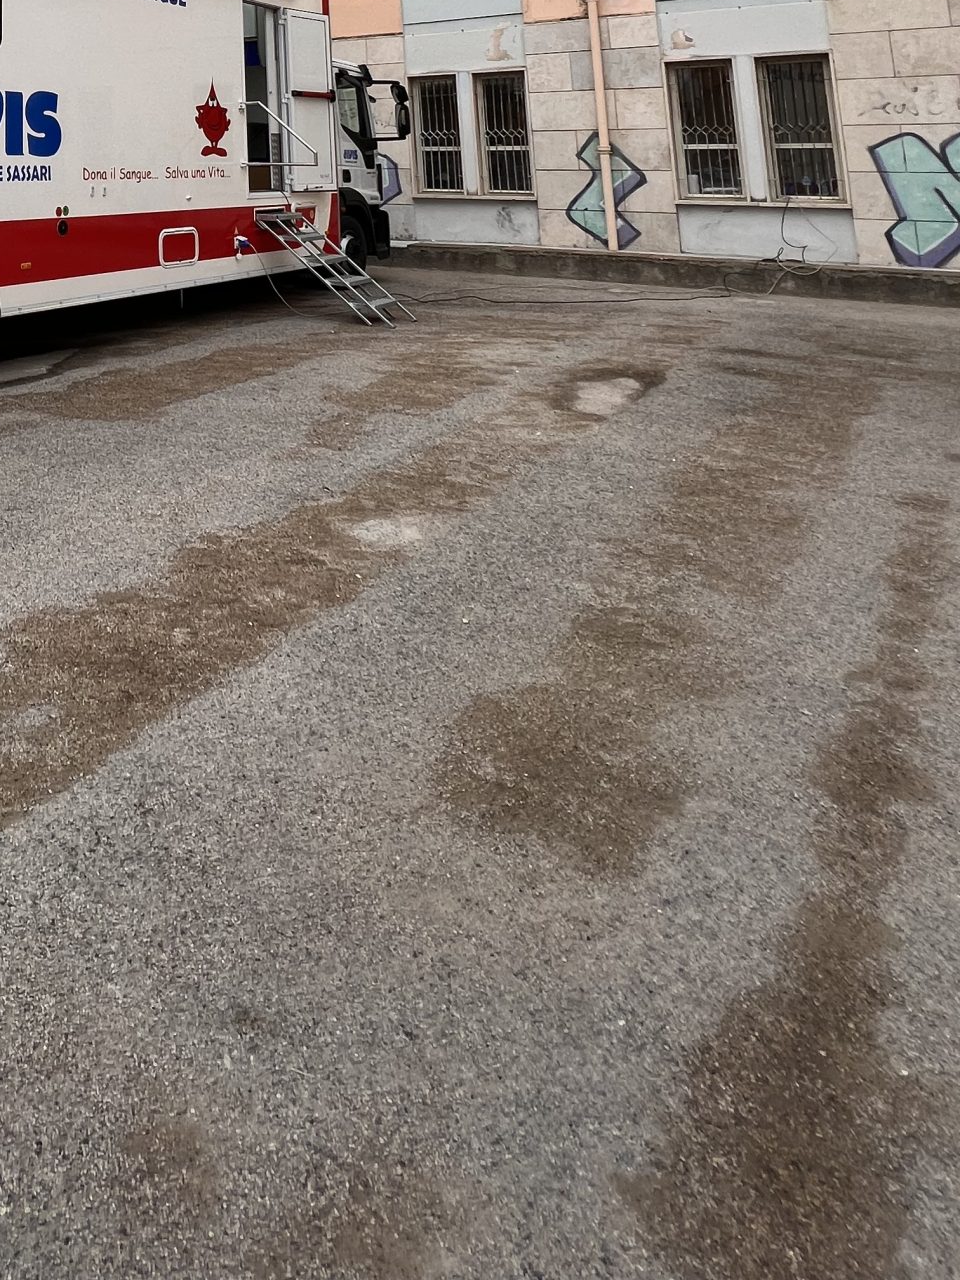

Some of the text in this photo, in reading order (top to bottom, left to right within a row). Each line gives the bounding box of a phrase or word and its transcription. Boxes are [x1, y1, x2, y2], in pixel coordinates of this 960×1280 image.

[6, 165, 52, 182] SASSARI
[82, 167, 108, 181] Dona
[110, 167, 116, 180] il
[165, 166, 189, 179] Salva
[191, 169, 206, 179] una
